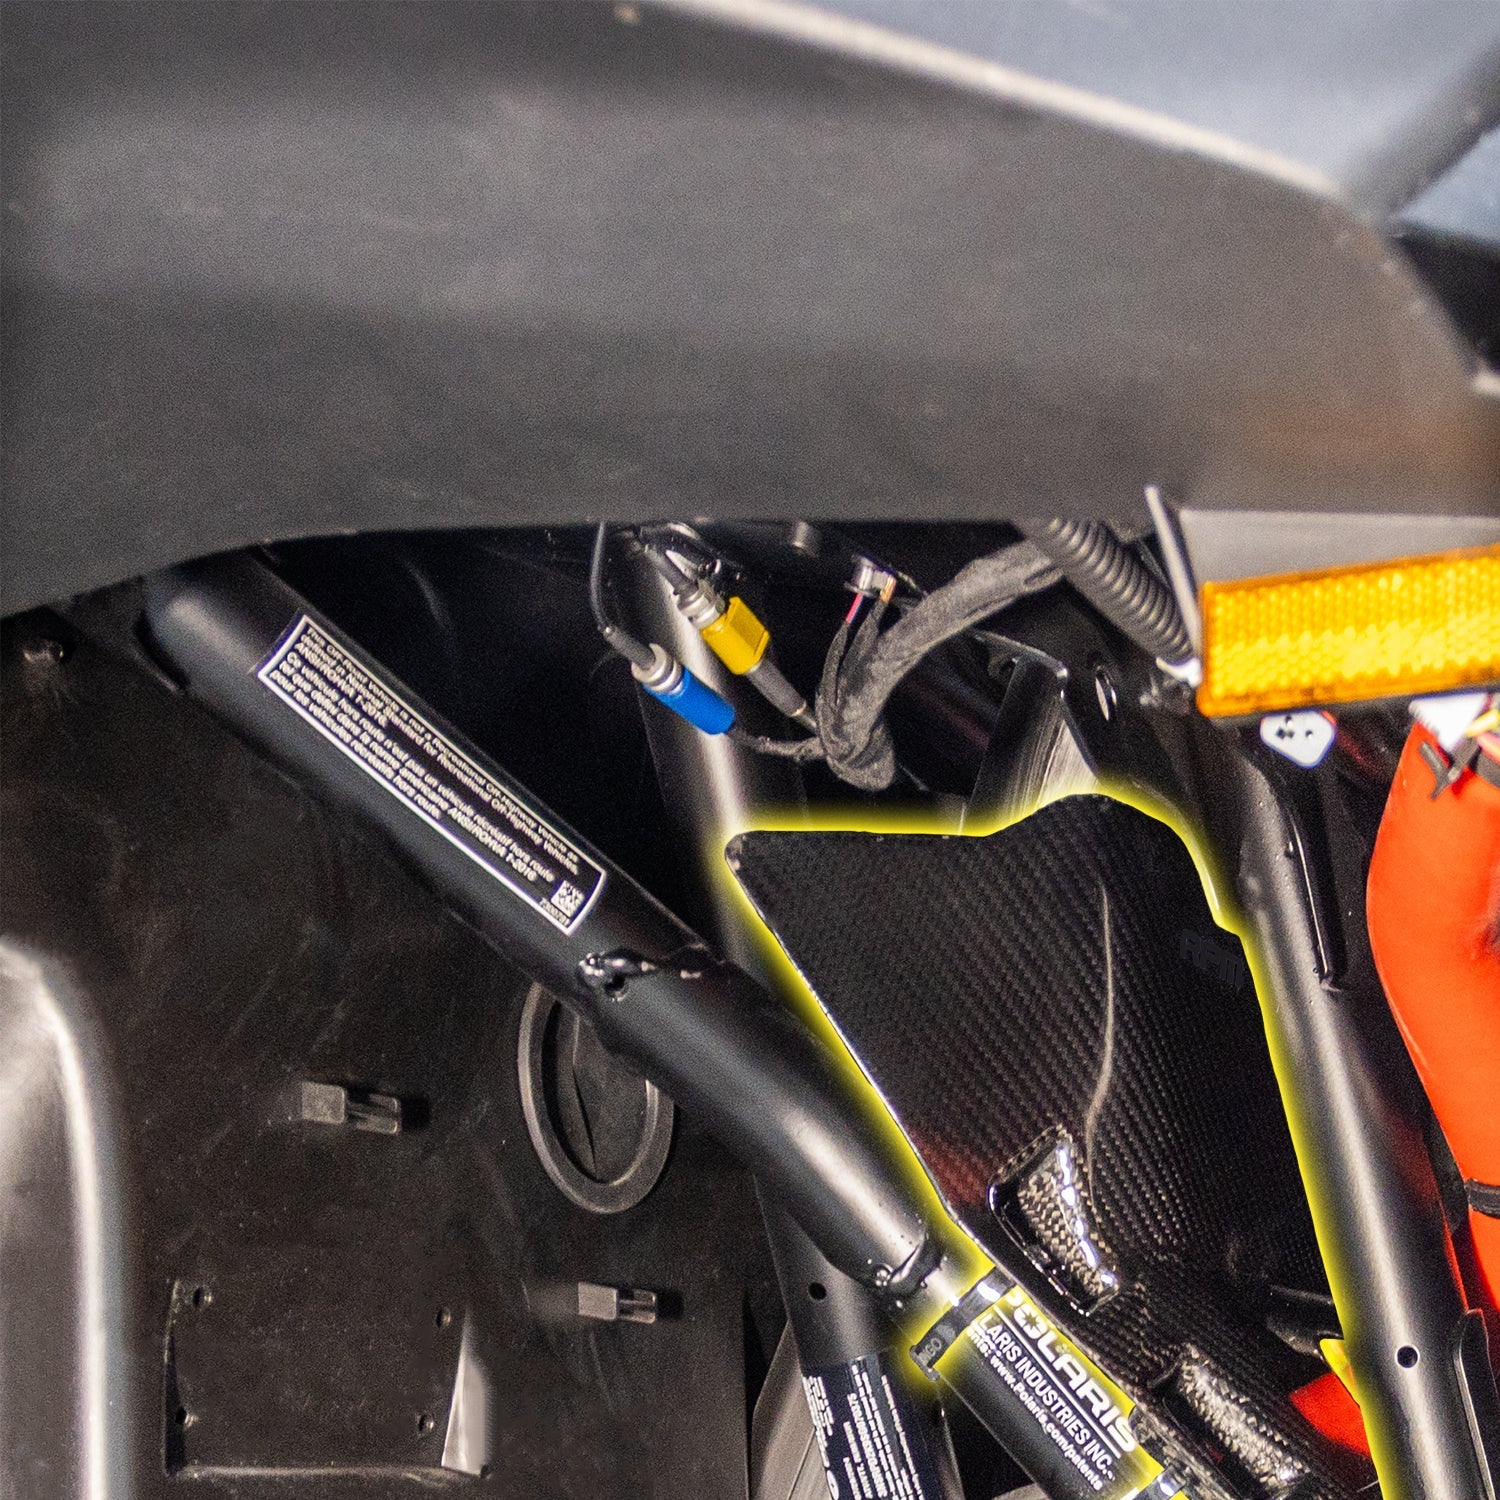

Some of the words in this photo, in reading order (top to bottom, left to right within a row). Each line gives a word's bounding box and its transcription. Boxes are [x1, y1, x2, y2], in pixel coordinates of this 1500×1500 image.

[268, 667, 297, 695] pour
[291, 687, 311, 707] les
[391, 773, 416, 798] hors
[277, 659, 295, 677] tel
[289, 671, 313, 695] que
[334, 710, 362, 737] dans
[358, 730, 372, 745] la
[367, 739, 402, 771] norme
[284, 650, 304, 670] Ce
[336, 697, 362, 722] hors
[357, 716, 386, 743] route
[404, 757, 426, 779] pas
[423, 772, 439, 788] un
[508, 841, 532, 865] hors
[528, 856, 556, 884] route
[299, 633, 337, 668] defined
[334, 664, 346, 676] in
[344, 673, 384, 709] National
[381, 705, 426, 746] Standard
[422, 740, 439, 758] for
[435, 752, 492, 803] Recreational
[488, 797, 543, 847] Off-Highway
[306, 627, 327, 647] This
[324, 644, 370, 684] Off-Road
[366, 681, 401, 713] Vehicle
[398, 709, 409, 721] is
[407, 717, 425, 734] not
[423, 731, 432, 740] a
[431, 736, 486, 786] Recreational
[484, 782, 538, 830] Off-Highway
[536, 824, 568, 854] Vehicle
[566, 850, 579, 863] as
[988, 1353, 1105, 1491] www.Polaris.com/patents
[1012, 1356, 1093, 1446] INDUSTRIES
